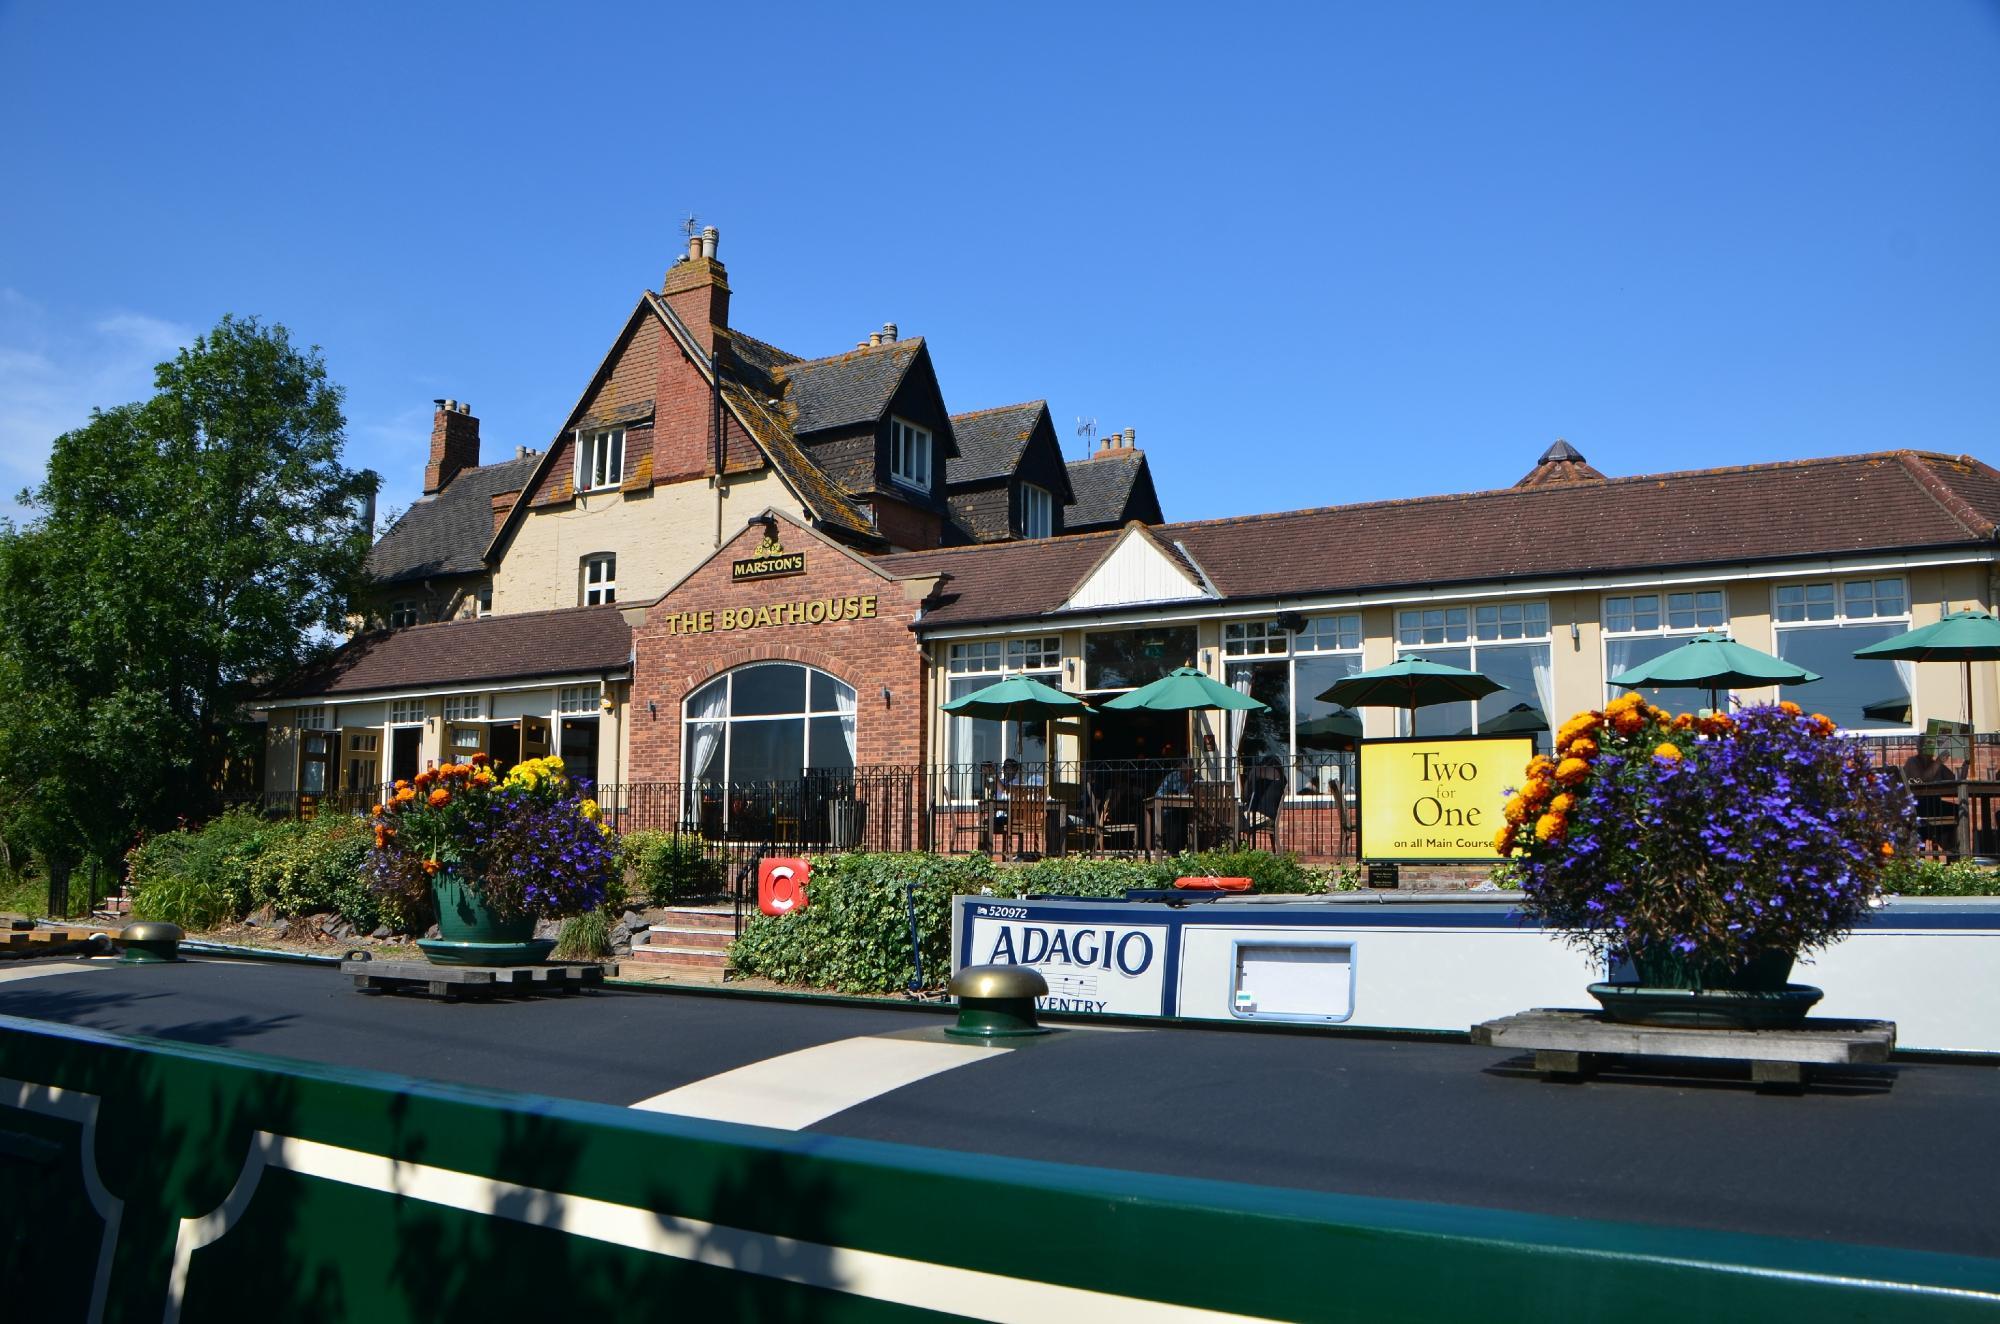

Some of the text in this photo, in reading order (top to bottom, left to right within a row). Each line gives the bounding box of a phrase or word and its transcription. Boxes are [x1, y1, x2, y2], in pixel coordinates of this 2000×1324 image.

[734, 556, 803, 576] MARSTON'S
[666, 595, 878, 635] THE BOATHOUSE
[1411, 752, 1478, 782] Two
[1436, 783, 1457, 799] for
[1412, 796, 1481, 827] One
[1394, 838, 1495, 848] on all Main Course
[988, 906, 1028, 919] 520972
[988, 925, 1154, 977] ADAGIO
[1036, 996, 1107, 1013] VENTRY
